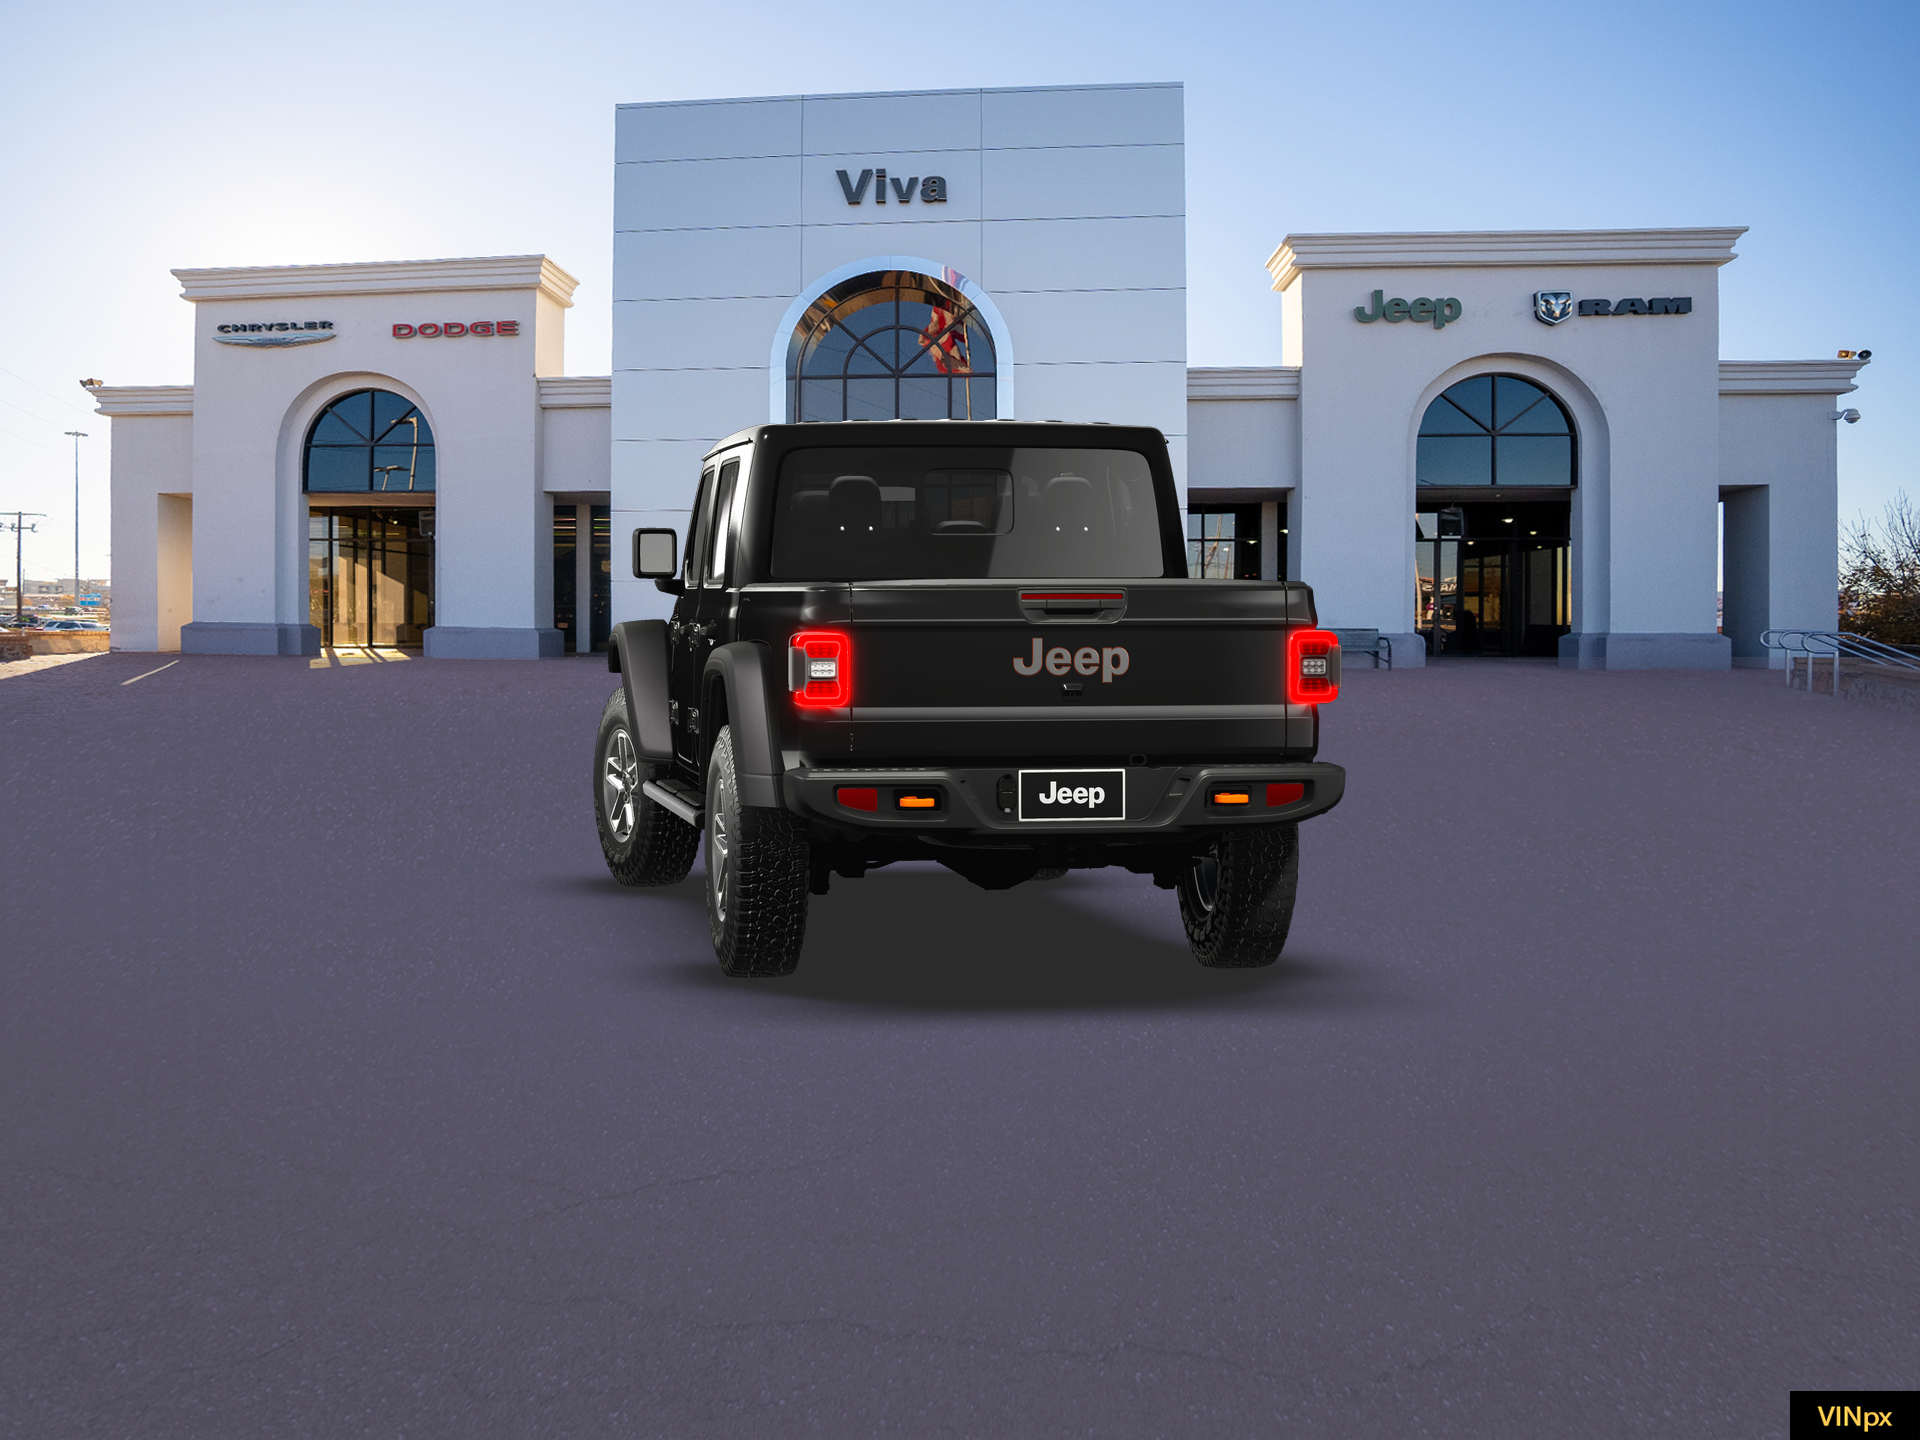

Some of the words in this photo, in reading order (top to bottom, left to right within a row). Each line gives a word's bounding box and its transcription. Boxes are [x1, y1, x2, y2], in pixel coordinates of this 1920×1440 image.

[835, 168, 947, 205] Viva
[1354, 289, 1463, 330] Jeep
[1578, 297, 1692, 317] RAM
[217, 321, 334, 334] CHRYSLER
[392, 319, 520, 339] DODGE
[1012, 637, 1130, 684] Jeep
[1039, 781, 1105, 808] Jeep
